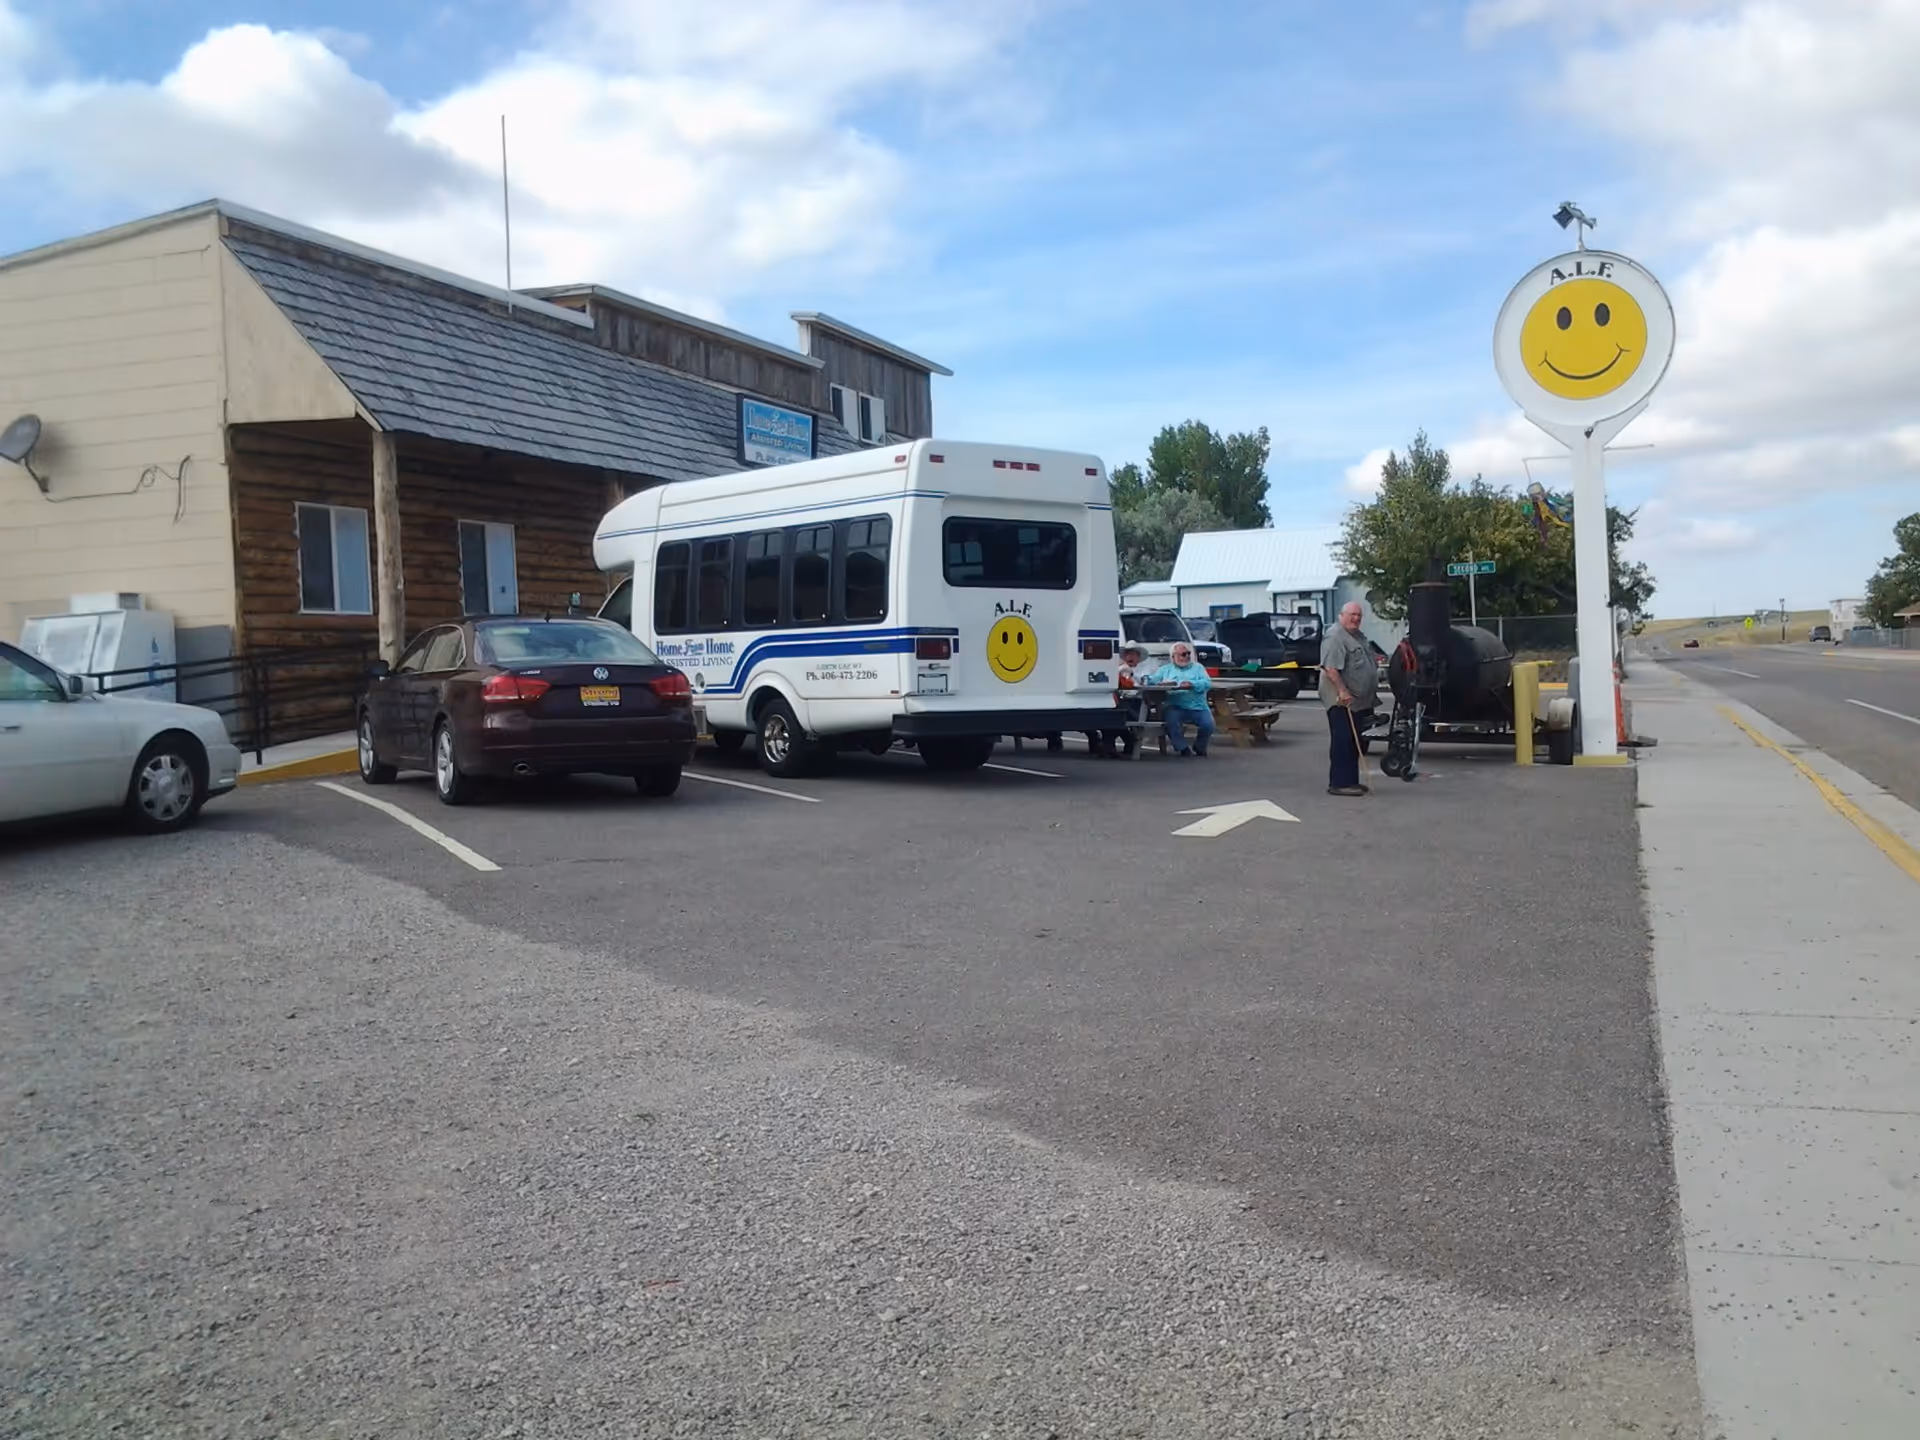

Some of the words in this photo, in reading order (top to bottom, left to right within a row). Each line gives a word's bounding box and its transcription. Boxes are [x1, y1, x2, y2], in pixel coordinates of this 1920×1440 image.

[1550, 261, 1614, 286] A.L.F.
[994, 599, 1032, 618] A.L.F.
[656, 641, 682, 656] Home
[706, 638, 734, 655] Home
[702, 656, 733, 667] LIVING
